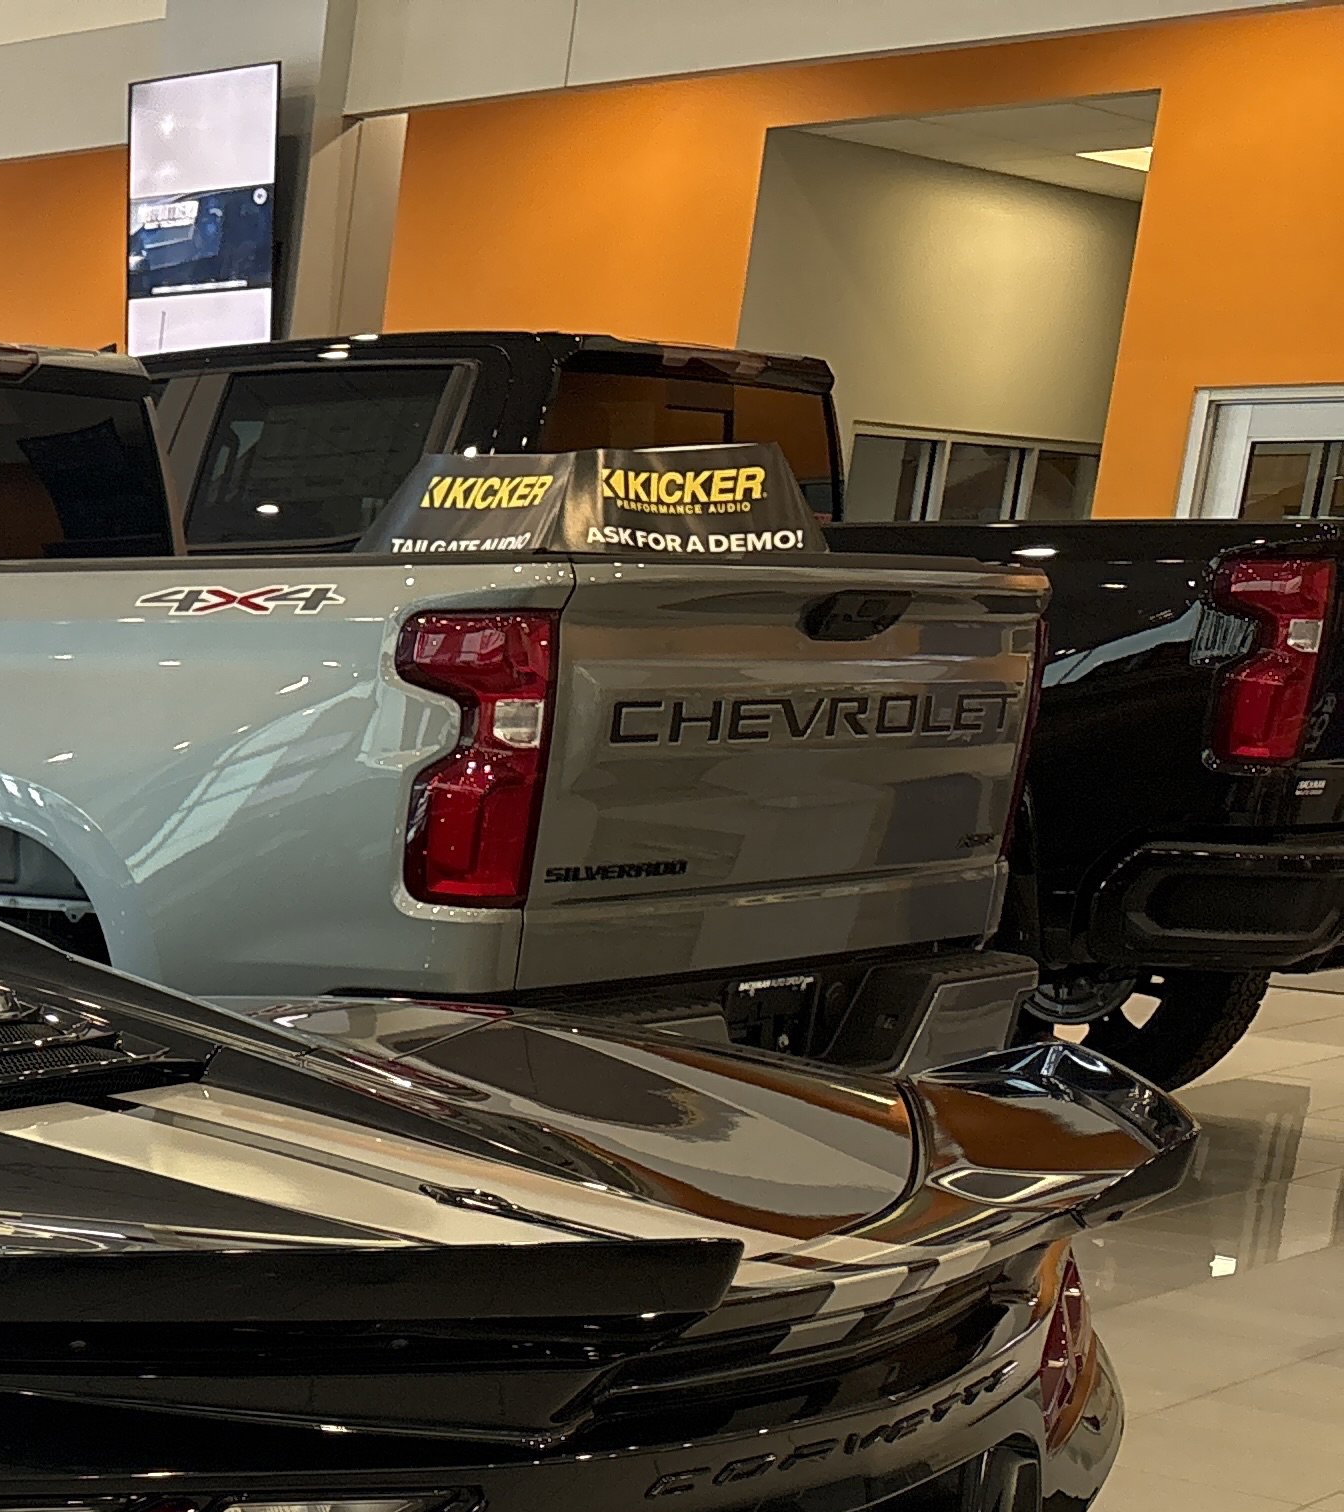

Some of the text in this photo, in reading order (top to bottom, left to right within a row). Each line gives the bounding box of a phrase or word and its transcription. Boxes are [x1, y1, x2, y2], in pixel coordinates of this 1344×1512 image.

[443, 475, 554, 509] KICKER
[628, 467, 765, 503] KICKER
[616, 500, 751, 515] PERFORMANCE AUDIO
[587, 526, 804, 553] ASK FOR A DEMO!
[609, 690, 1020, 746] CHEVROLET
[544, 859, 688, 884] SILVERADO
